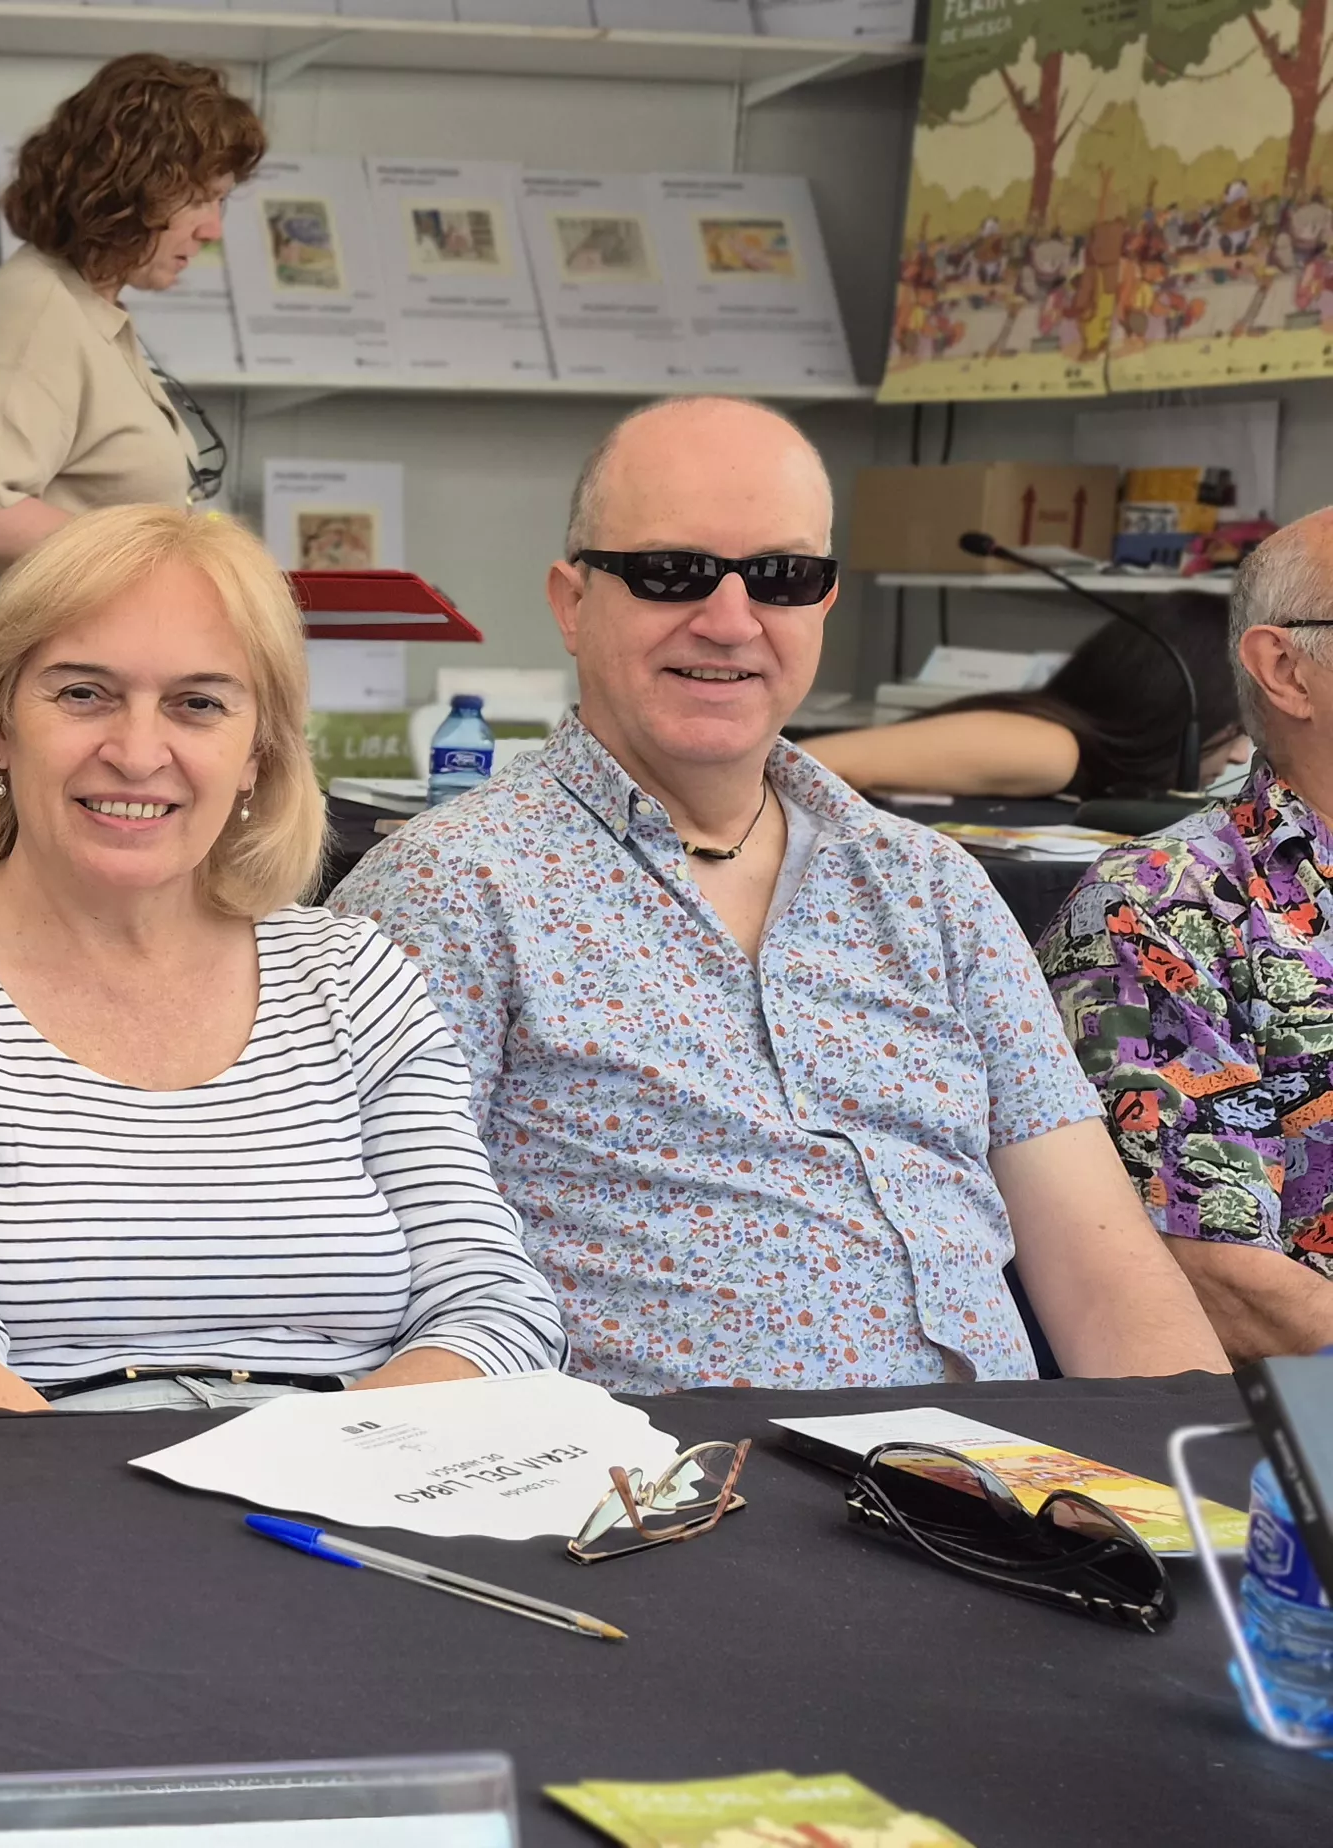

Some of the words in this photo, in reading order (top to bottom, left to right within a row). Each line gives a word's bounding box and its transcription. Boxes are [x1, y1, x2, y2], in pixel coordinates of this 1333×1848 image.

[514, 1444, 589, 1470] FERIA
[464, 1465, 523, 1484] DEL
[393, 1479, 474, 1505] LIBRO
